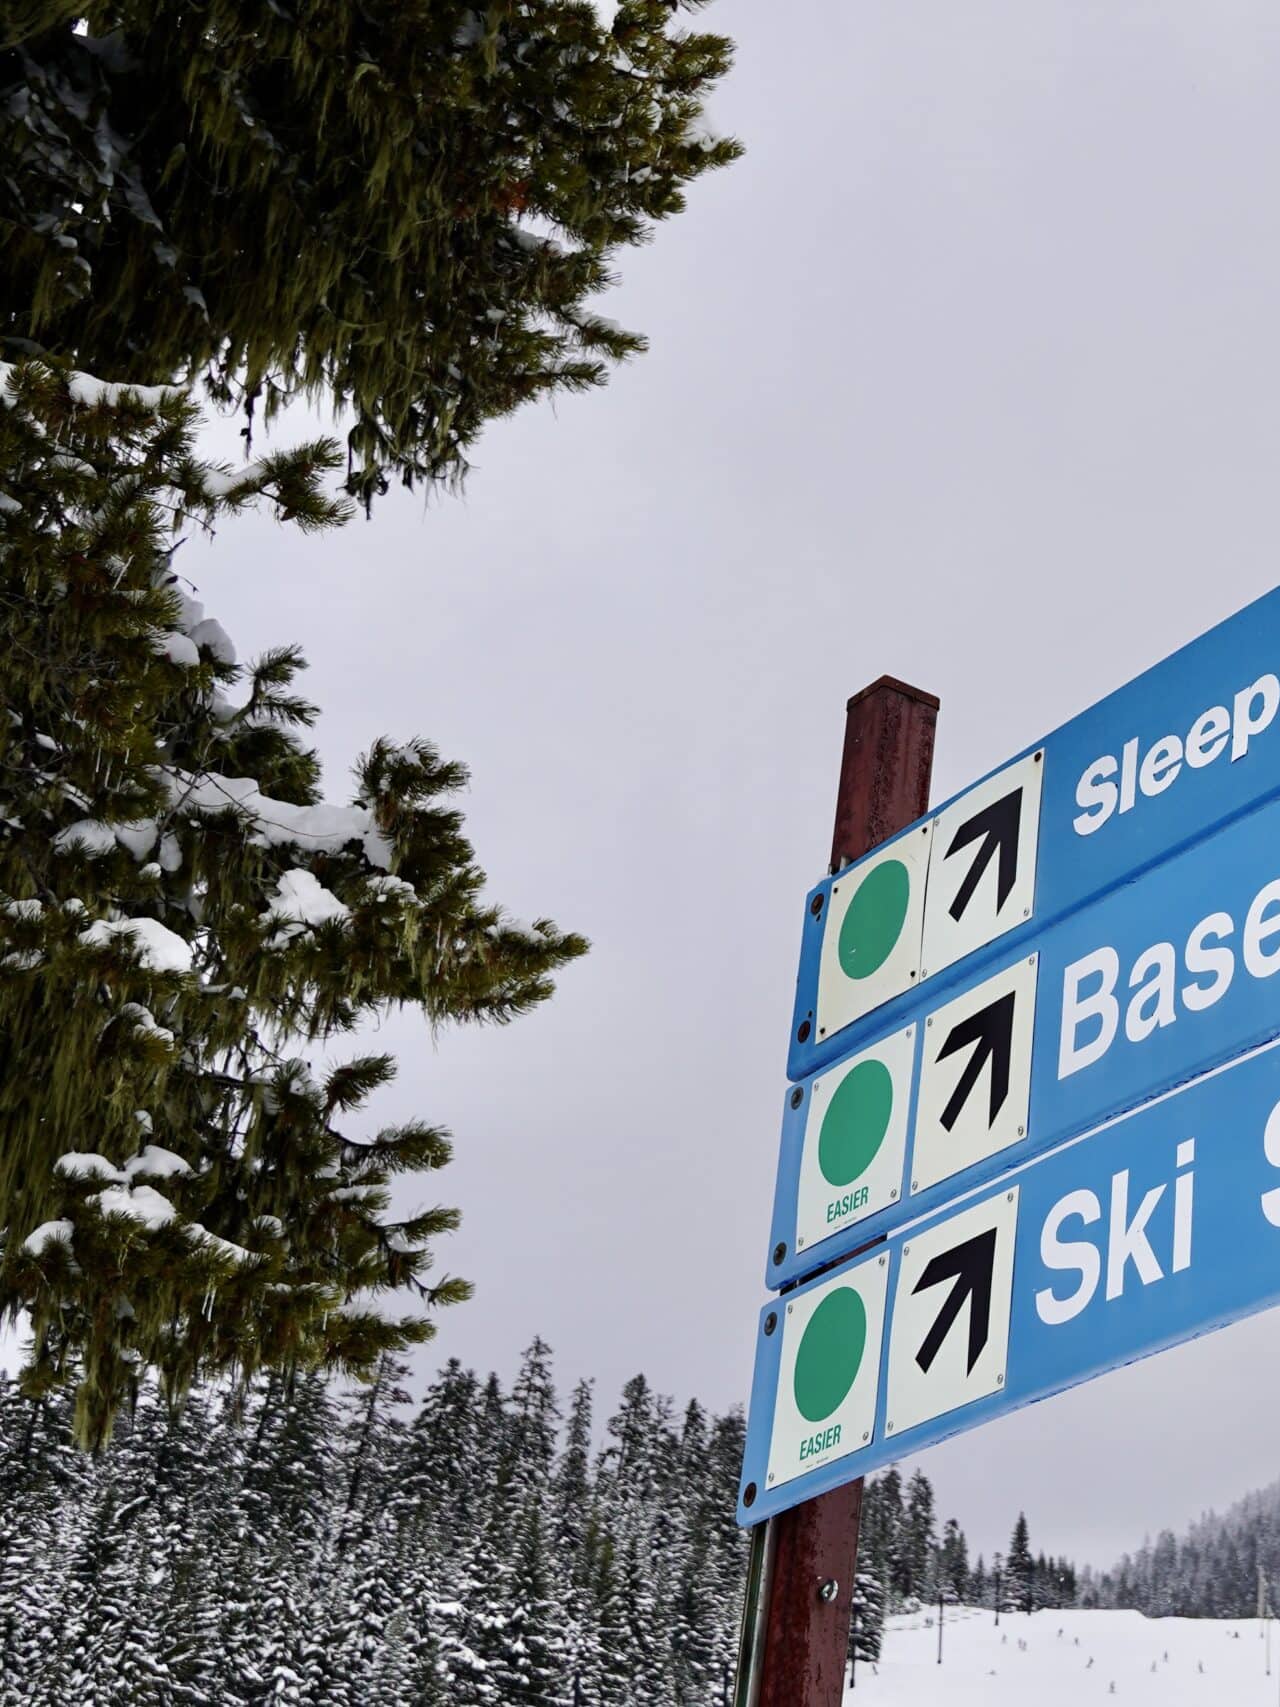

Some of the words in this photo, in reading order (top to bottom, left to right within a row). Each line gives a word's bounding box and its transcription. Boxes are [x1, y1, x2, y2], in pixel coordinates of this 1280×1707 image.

[826, 1185, 869, 1224] EASIER
[1035, 1138, 1196, 1325] Ski
[799, 1423, 842, 1462] EASIER
